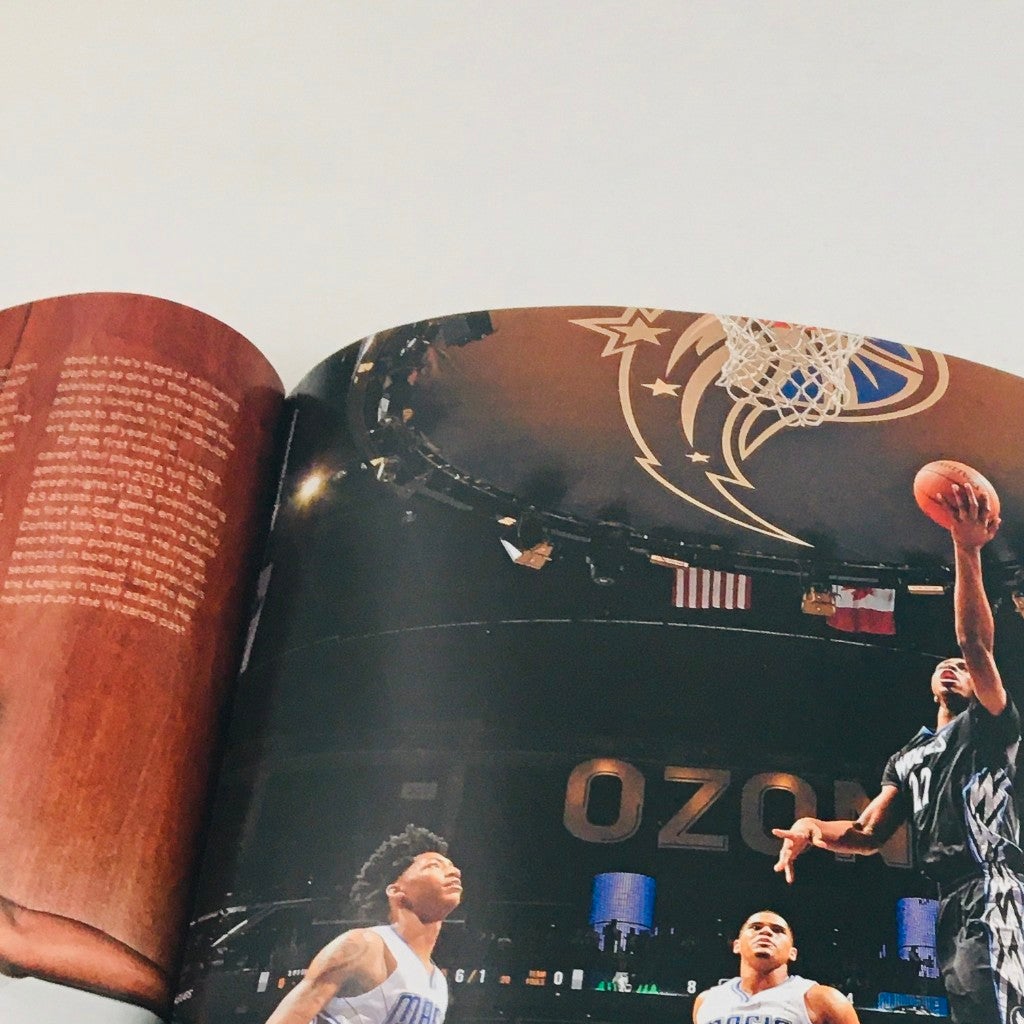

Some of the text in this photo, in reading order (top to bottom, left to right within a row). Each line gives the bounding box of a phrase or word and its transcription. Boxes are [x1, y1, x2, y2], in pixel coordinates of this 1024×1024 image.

[174, 370, 188, 380] of
[125, 373, 149, 383] one
[151, 377, 165, 386] of
[167, 381, 188, 395] the
[174, 398, 193, 412] the
[94, 409, 107, 419] to
[154, 465, 163, 473] a
[110, 483, 125, 491] of
[156, 495, 194, 515] points
[118, 499, 155, 514] game
[158, 510, 175, 521] en
[19, 521, 67, 531] Contest
[99, 524, 112, 533] to
[152, 537, 170, 550] He
[179, 534, 186, 542] a
[81, 550, 112, 564] both
[114, 558, 129, 567] of
[131, 560, 153, 575] the
[146, 550, 174, 567] than
[132, 577, 158, 591] and
[160, 584, 175, 599] he
[79, 596, 100, 607] the
